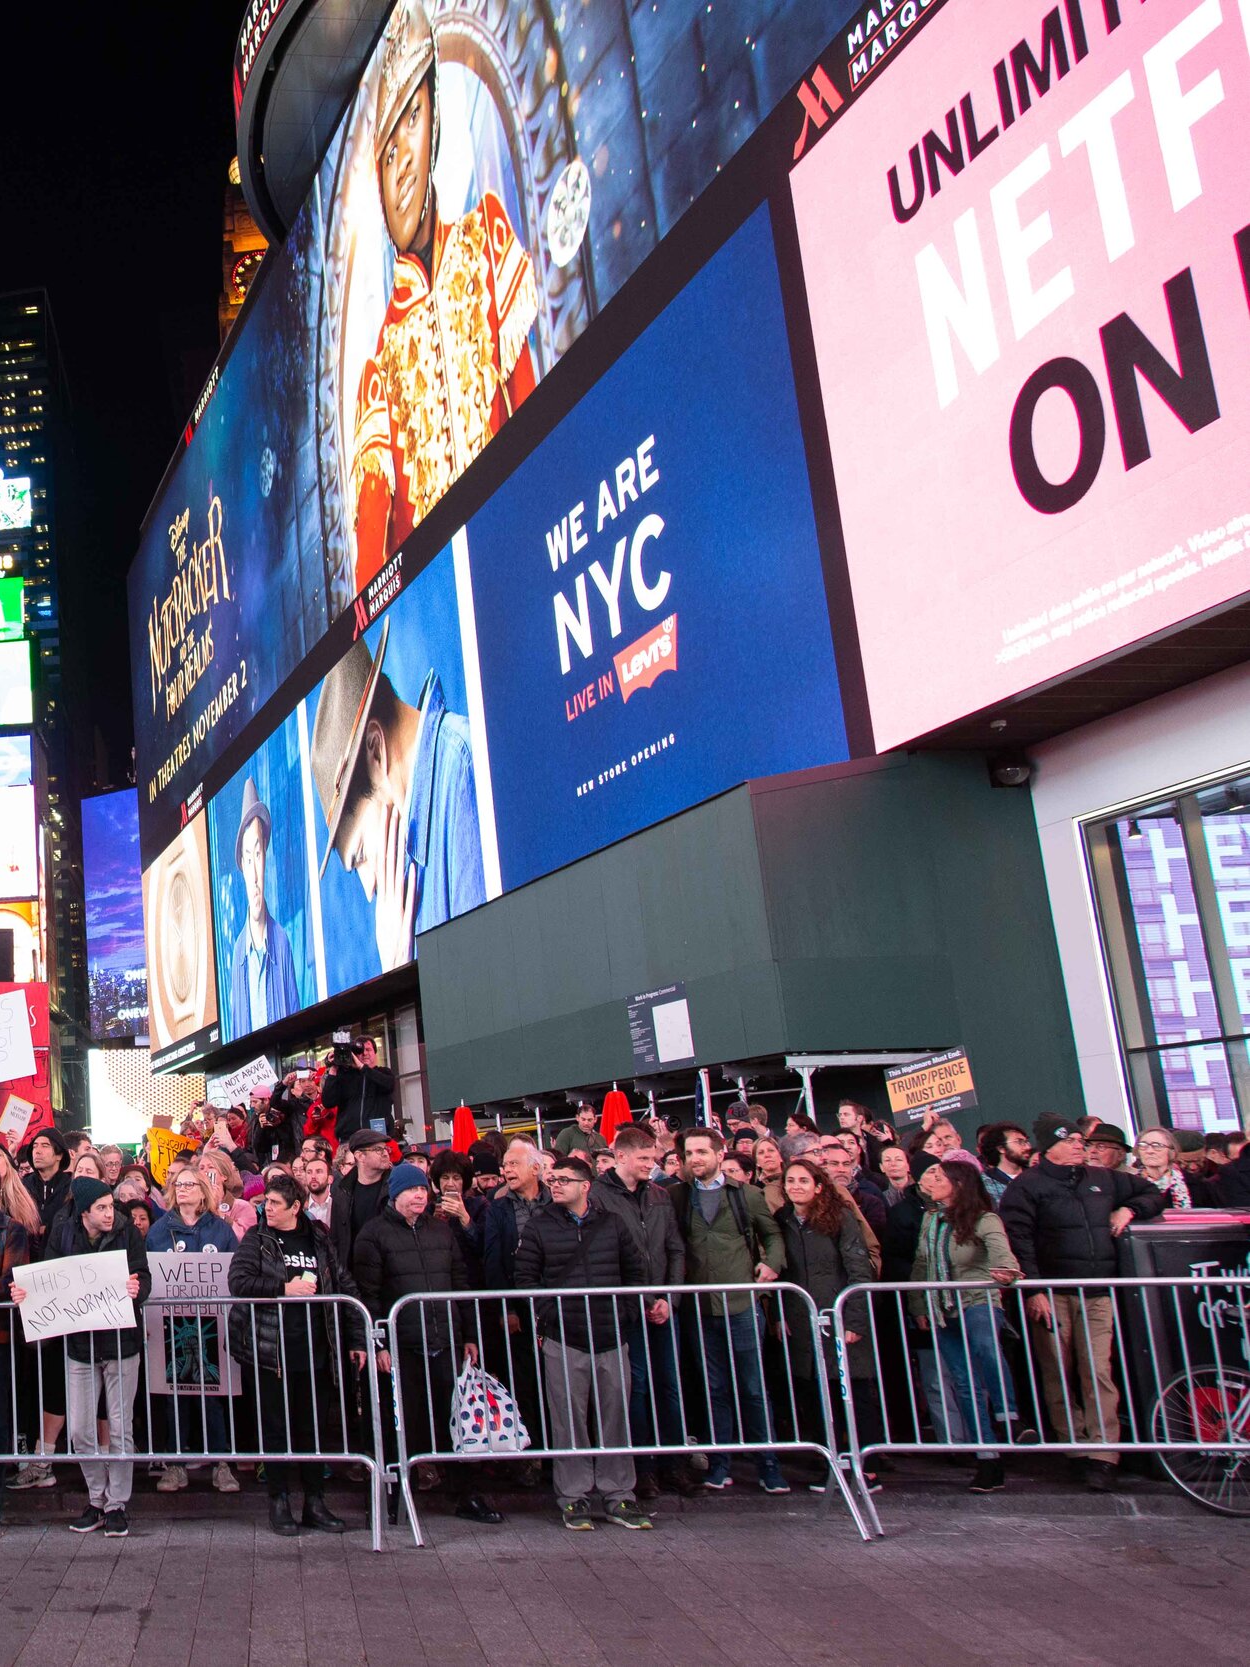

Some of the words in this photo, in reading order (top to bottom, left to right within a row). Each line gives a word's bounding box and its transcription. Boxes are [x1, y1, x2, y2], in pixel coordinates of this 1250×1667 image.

[1009, 266, 1221, 515] ON
[545, 501, 588, 572] WE
[596, 434, 660, 533] ARE
[1187, 526, 1227, 553] Video
[368, 552, 403, 600] MARRIOTT
[369, 574, 401, 617] MARQUIS
[553, 513, 672, 675] NYC
[147, 496, 231, 716] NUTCRACKER
[165, 667, 186, 722] FOUR
[184, 622, 215, 697] REALMS
[564, 682, 597, 722] LIVE
[598, 671, 614, 701] IN
[149, 781, 158, 804] IN
[157, 736, 192, 793] THEATRES
[192, 682, 240, 741] NOVEMBER
[240, 660, 248, 688] 2
[576, 780, 594, 798] NEW
[598, 759, 627, 787] STORE
[631, 732, 676, 769] OPENING
[225, 1075, 240, 1089] NOT
[242, 1060, 265, 1077] ABOVE
[231, 1087, 248, 1098] THE
[253, 1070, 273, 1086] LAW!
[888, 1069, 901, 1078] This
[901, 1059, 932, 1073] Nightmare
[931, 1054, 948, 1064] Must
[948, 1049, 962, 1059] End:
[891, 1061, 966, 1094] TRUMP/PENCE
[905, 1086, 935, 1105] MUST
[937, 1080, 957, 1096] GO!
[24, 1268, 71, 1294] THIS
[79, 1264, 97, 1285] IS
[158, 1262, 223, 1283] WEEP
[285, 1251, 318, 1269] esist
[28, 1297, 62, 1333] NOT
[63, 1284, 128, 1322] NORMAL
[166, 1284, 189, 1298] FOR
[191, 1284, 219, 1298] OUR
